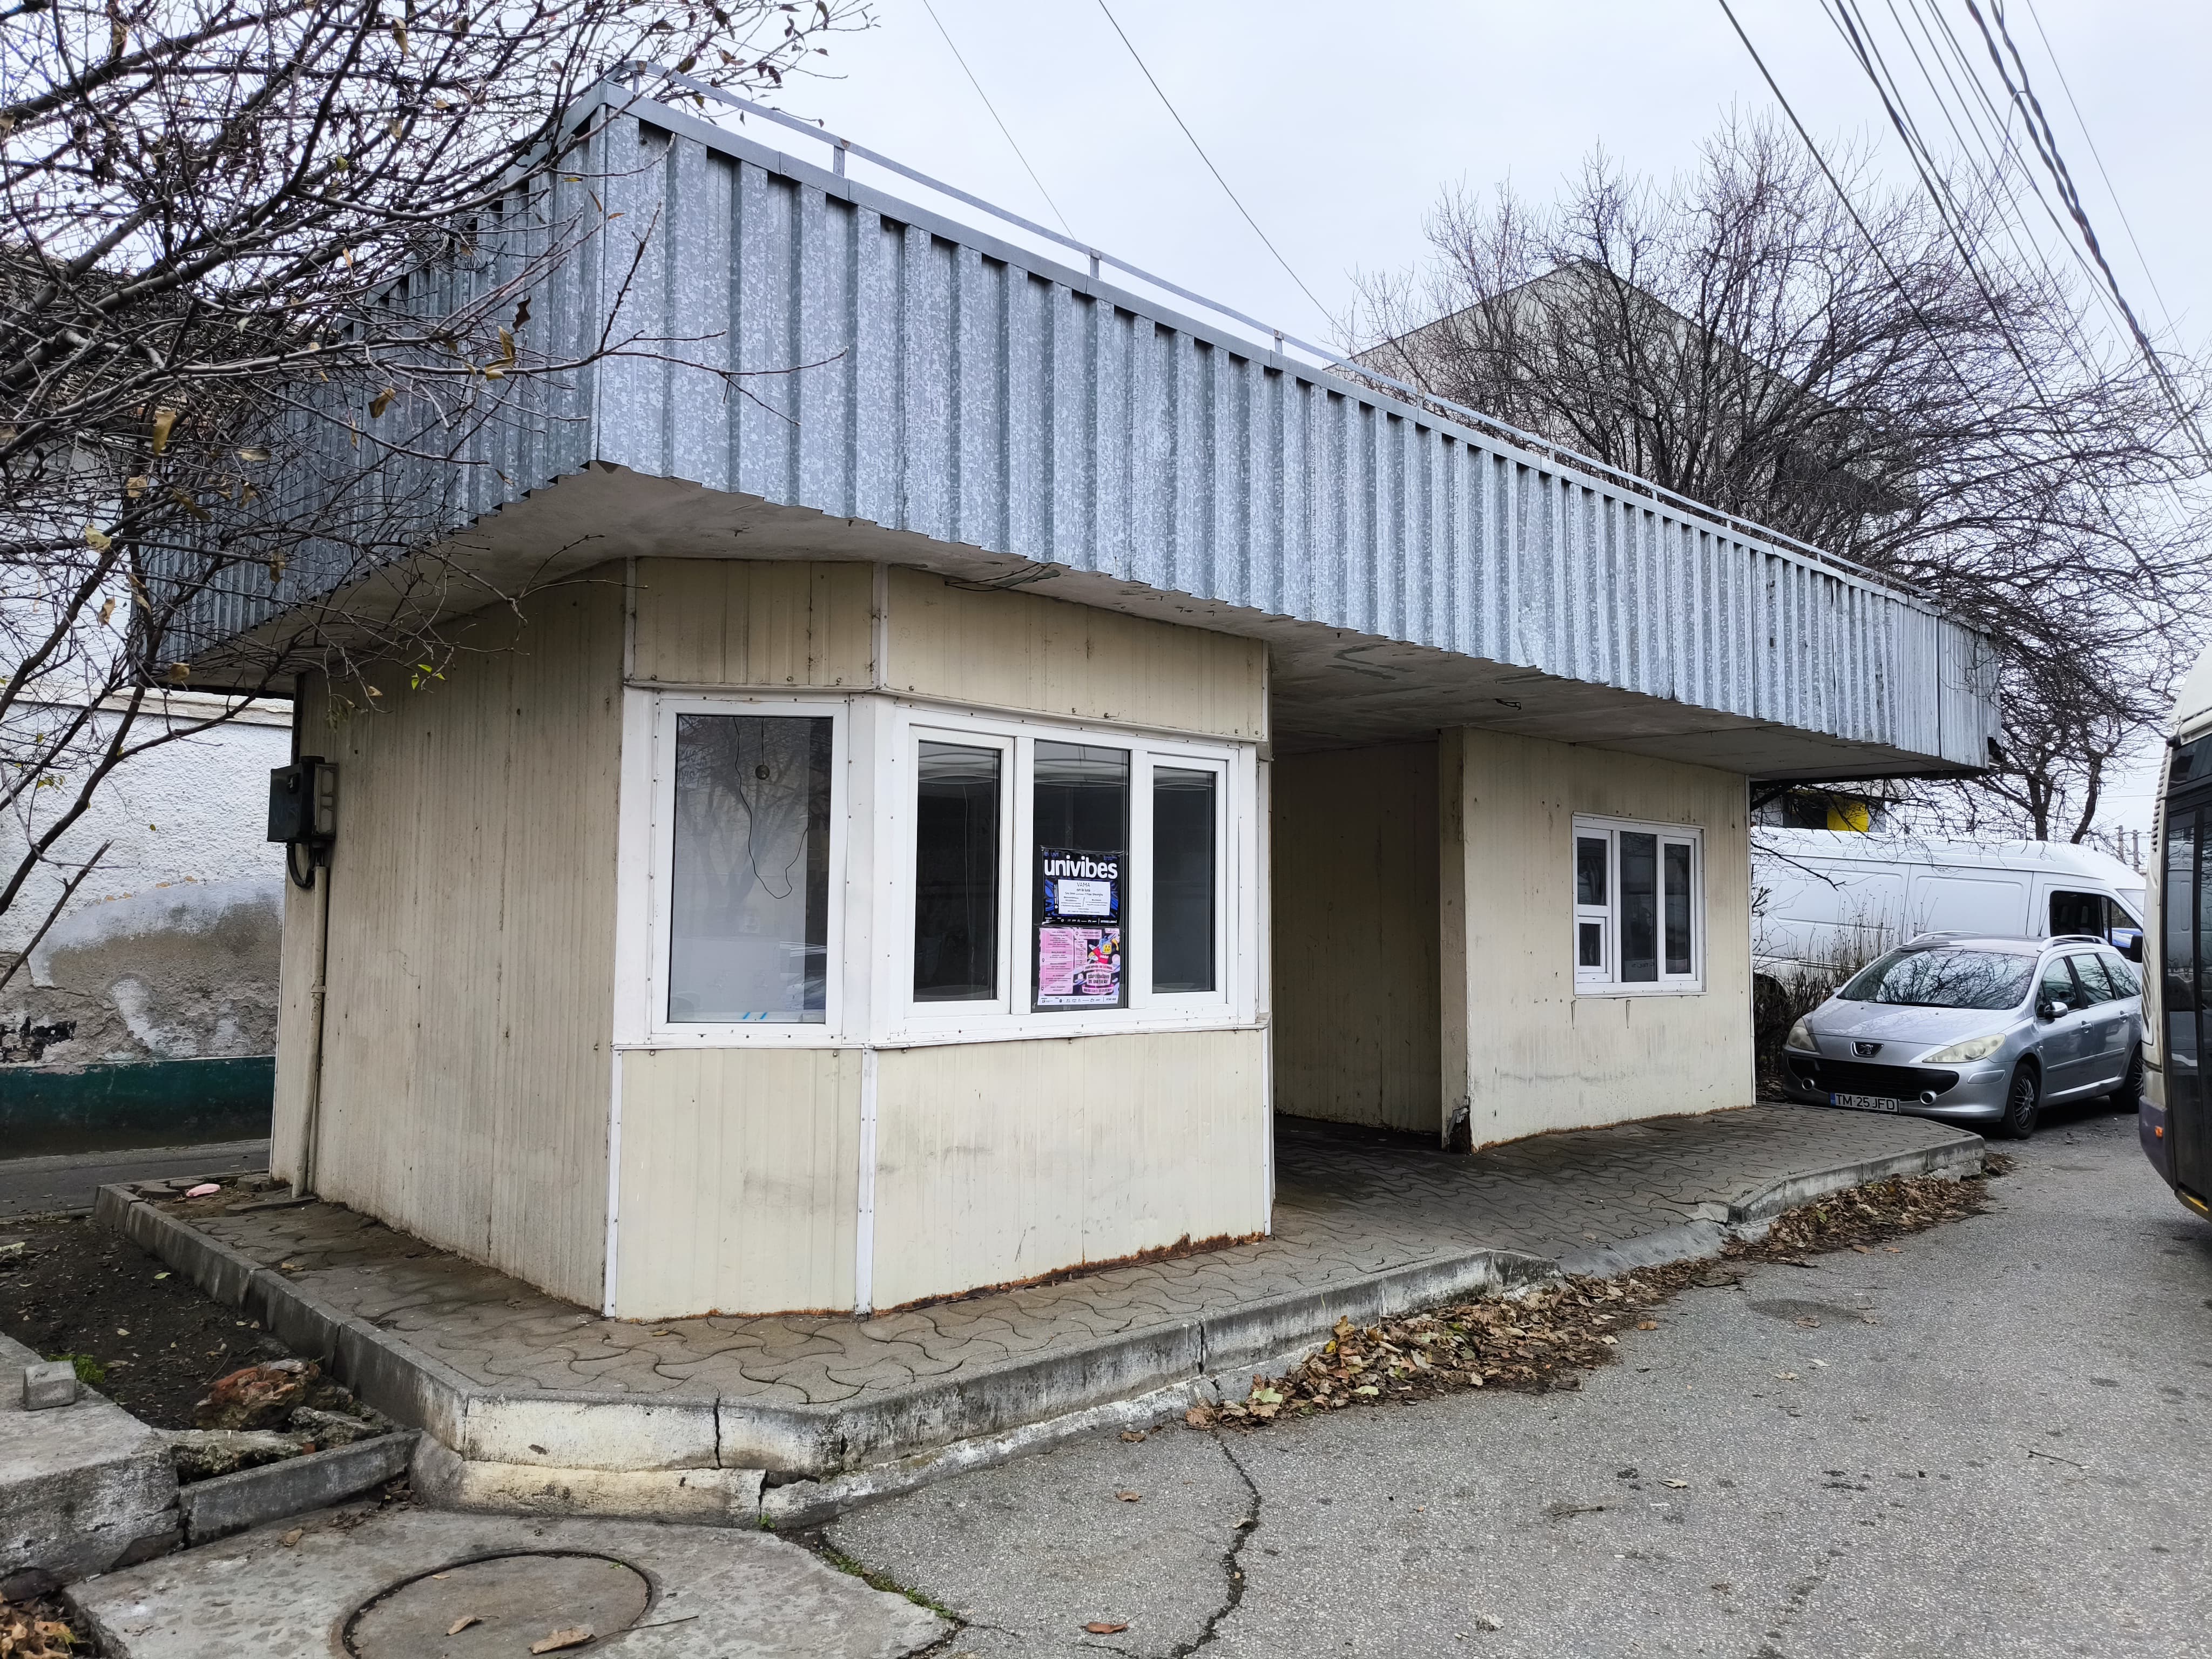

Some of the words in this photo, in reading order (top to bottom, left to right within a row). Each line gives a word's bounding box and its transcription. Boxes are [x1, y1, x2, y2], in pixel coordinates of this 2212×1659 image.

[1044, 855, 1118, 879] univibes
[1836, 1094, 1852, 1106] TM
[1856, 1096, 1870, 1108] 25
[1872, 1098, 1894, 1110] JFD
